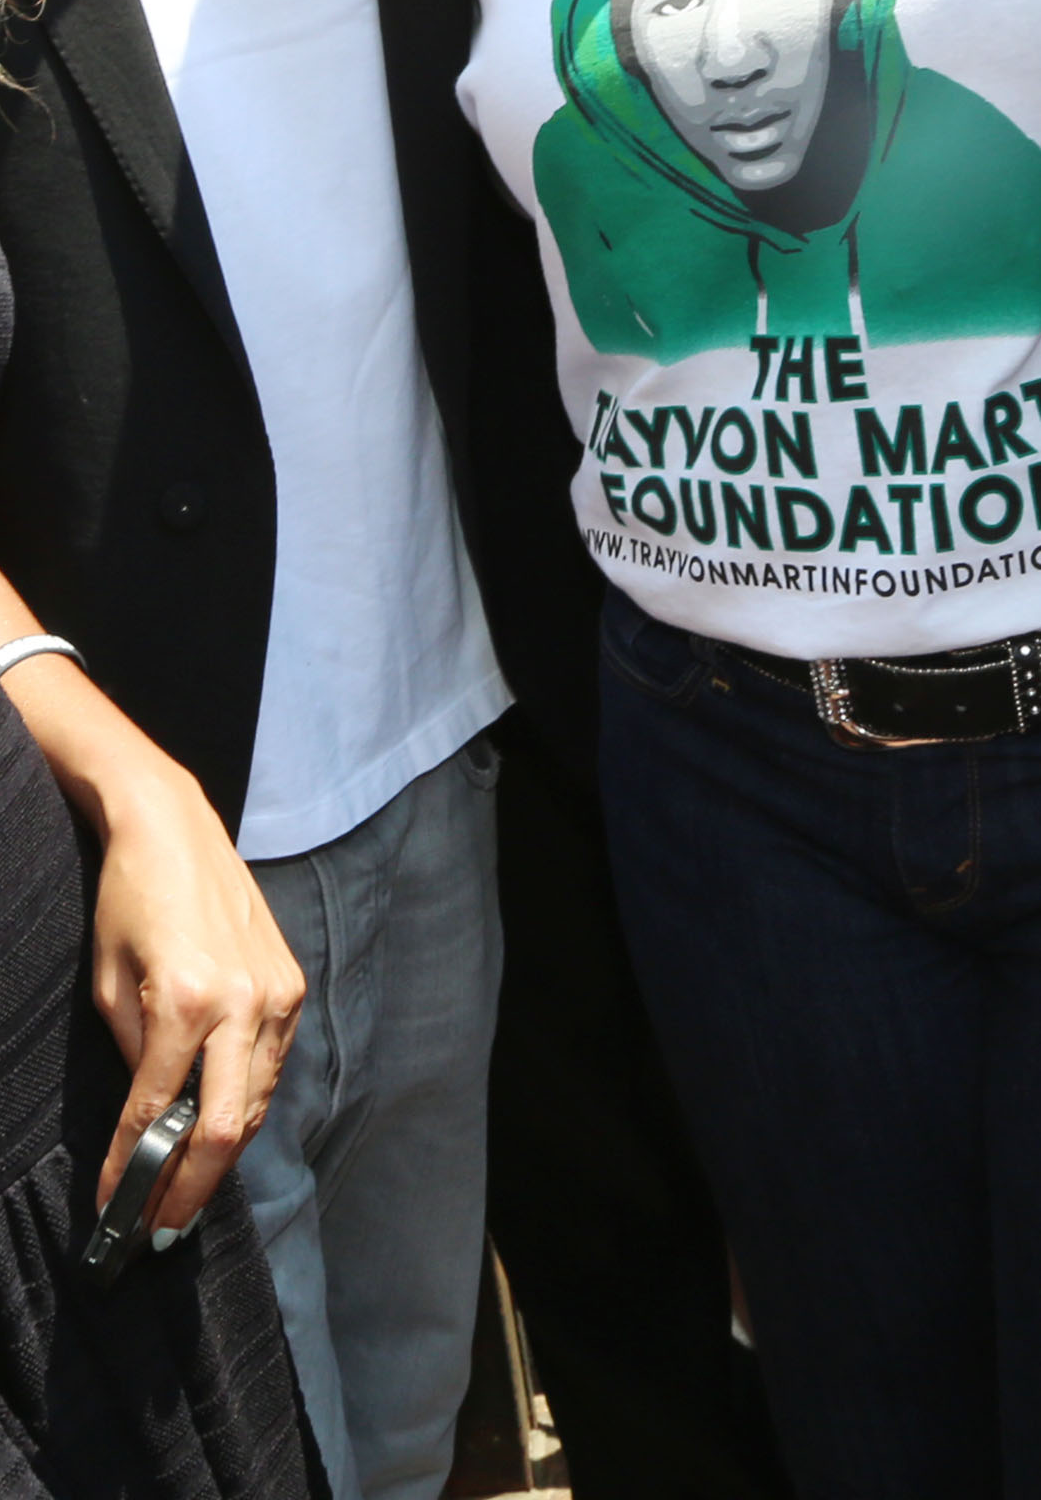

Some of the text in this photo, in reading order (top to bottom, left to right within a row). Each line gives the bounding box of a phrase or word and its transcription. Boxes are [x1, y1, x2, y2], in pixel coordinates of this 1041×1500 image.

[749, 335, 870, 403] THE
[588, 388, 819, 479] TAYVON
[600, 461, 1041, 556] FOUNDATIO
